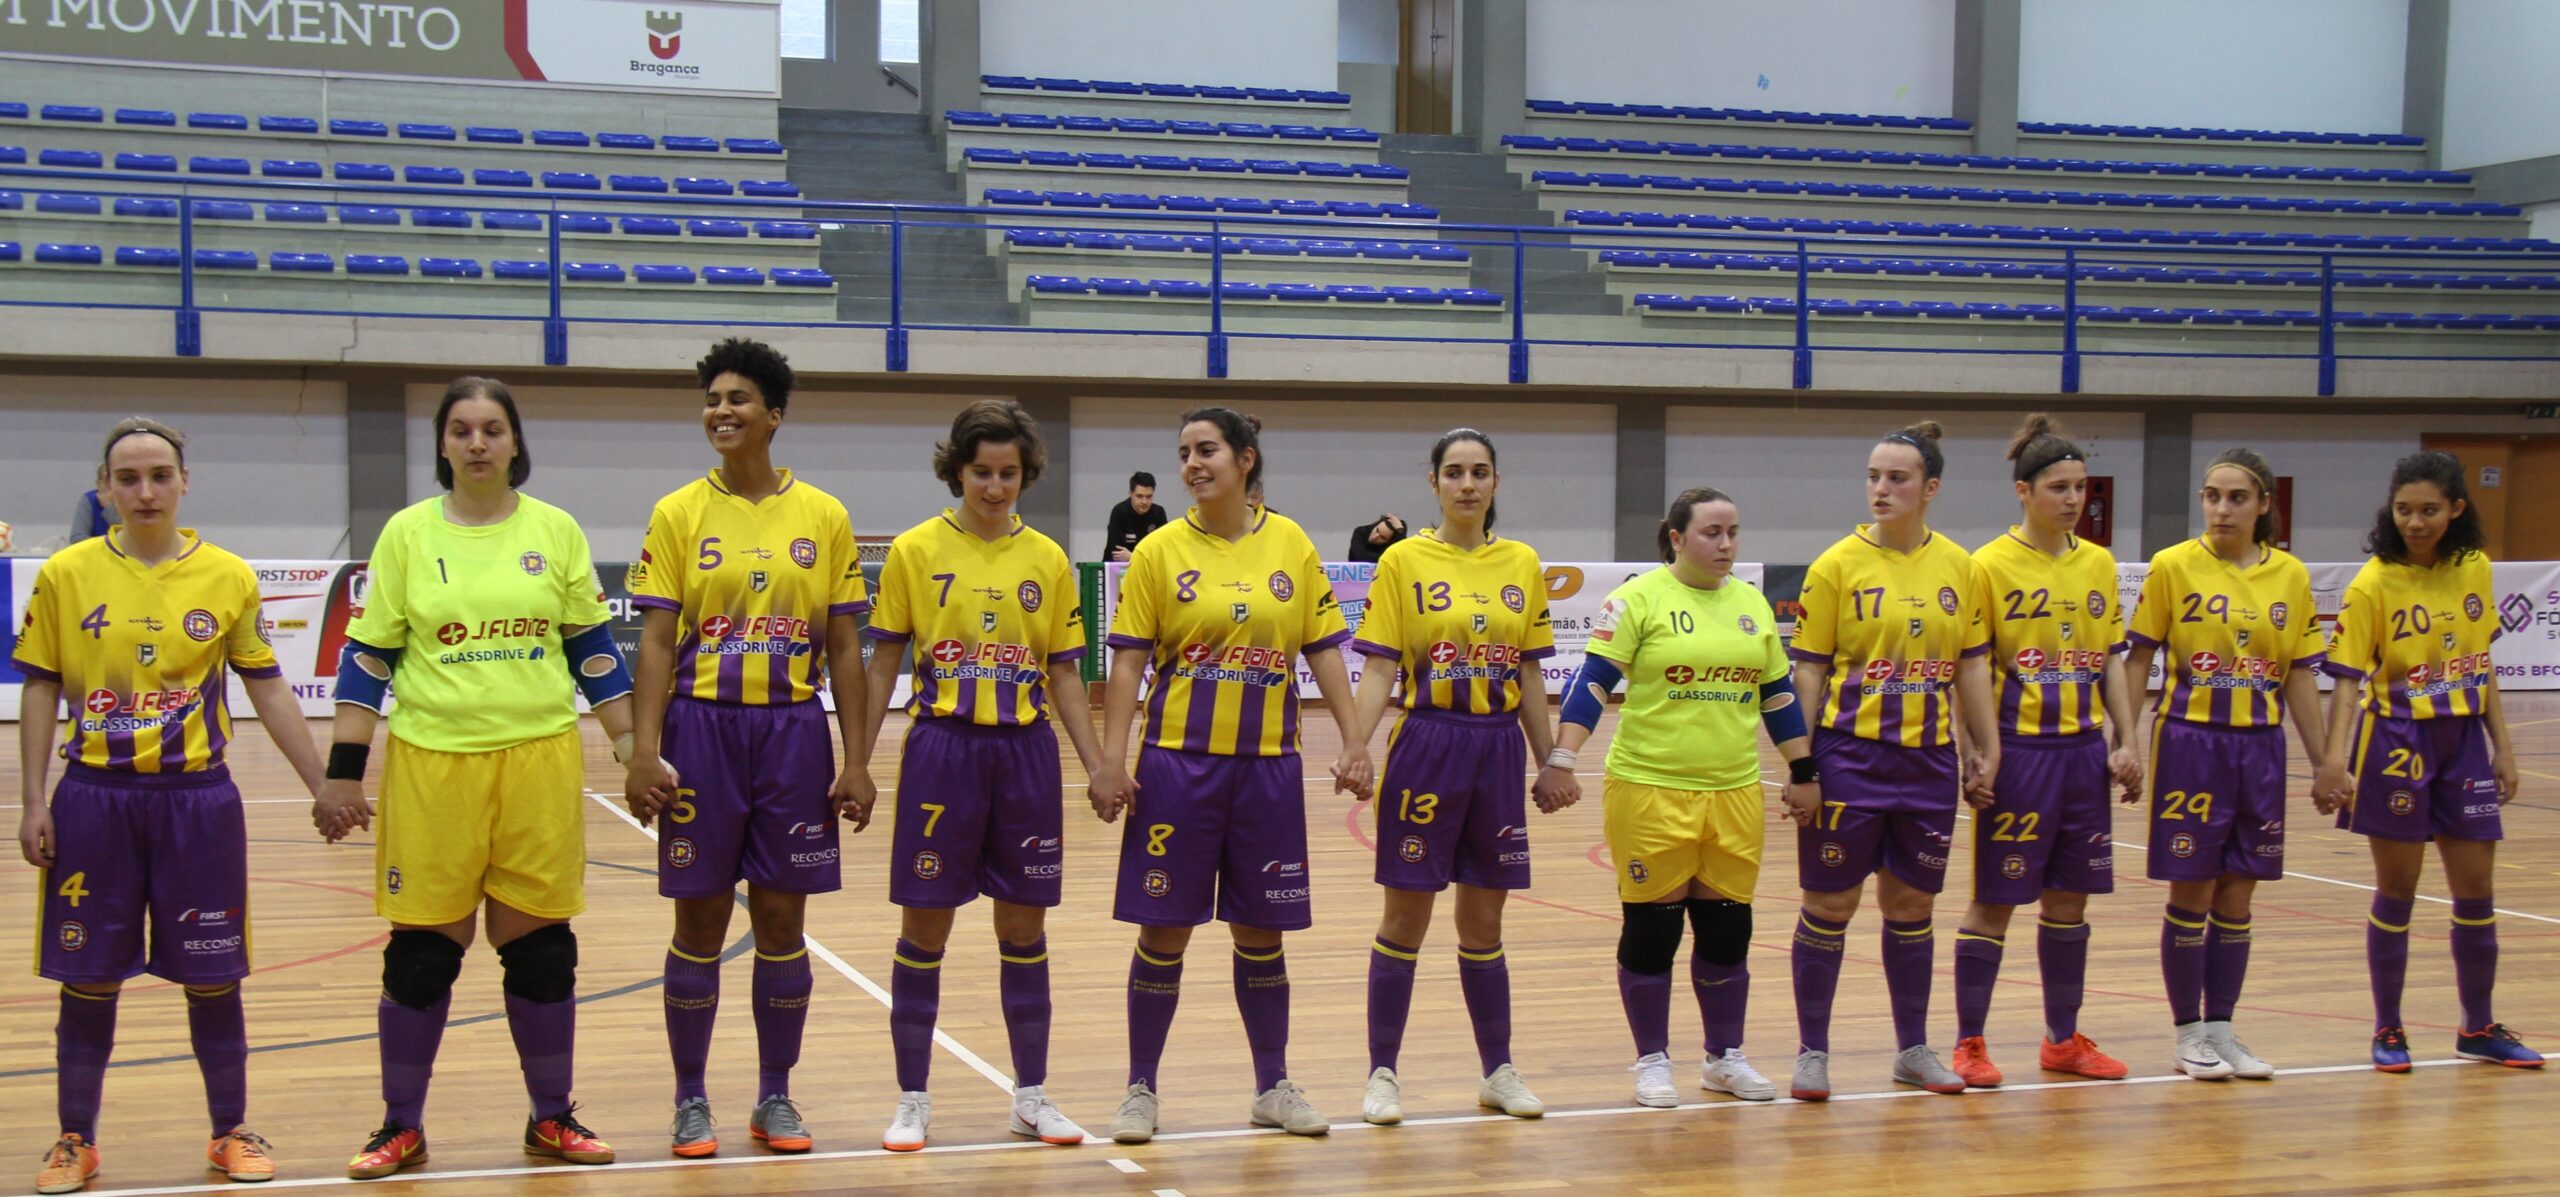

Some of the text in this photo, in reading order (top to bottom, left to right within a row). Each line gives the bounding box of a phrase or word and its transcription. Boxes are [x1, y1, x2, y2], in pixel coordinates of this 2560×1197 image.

[47, 0, 461, 51] MOVIMENTO
[630, 60, 700, 76] Bragança
[698, 537, 722, 570] 5
[255, 569, 329, 582] IRSTSTOP
[437, 558, 448, 584] 1
[1176, 570, 1201, 602] 8
[931, 573, 956, 608] 7
[1412, 581, 1452, 615] 13
[1852, 587, 1885, 621] 17
[2003, 588, 2052, 621] 22
[81, 603, 110, 639] 4
[1669, 610, 1694, 634] 10
[2180, 592, 2229, 624] 29
[2391, 604, 2430, 642] 20
[440, 648, 525, 665] GLASSDRIVE
[700, 641, 784, 655] GLASSDRIVE
[934, 666, 1011, 682] GLASSDRIVE
[1175, 665, 1258, 685] GLASSDRIVE
[1667, 690, 1738, 703] GLASSDRIVE
[2382, 748, 2424, 780] 20
[670, 788, 697, 823] 5
[920, 803, 945, 837] 7
[1399, 789, 1439, 824] 13
[2160, 790, 2213, 823] 29
[1146, 823, 1175, 857] 8
[1991, 811, 2040, 842] 22
[790, 848, 838, 863] RECONCO
[1280, 863, 1302, 872] FIRST
[59, 872, 89, 907] 4
